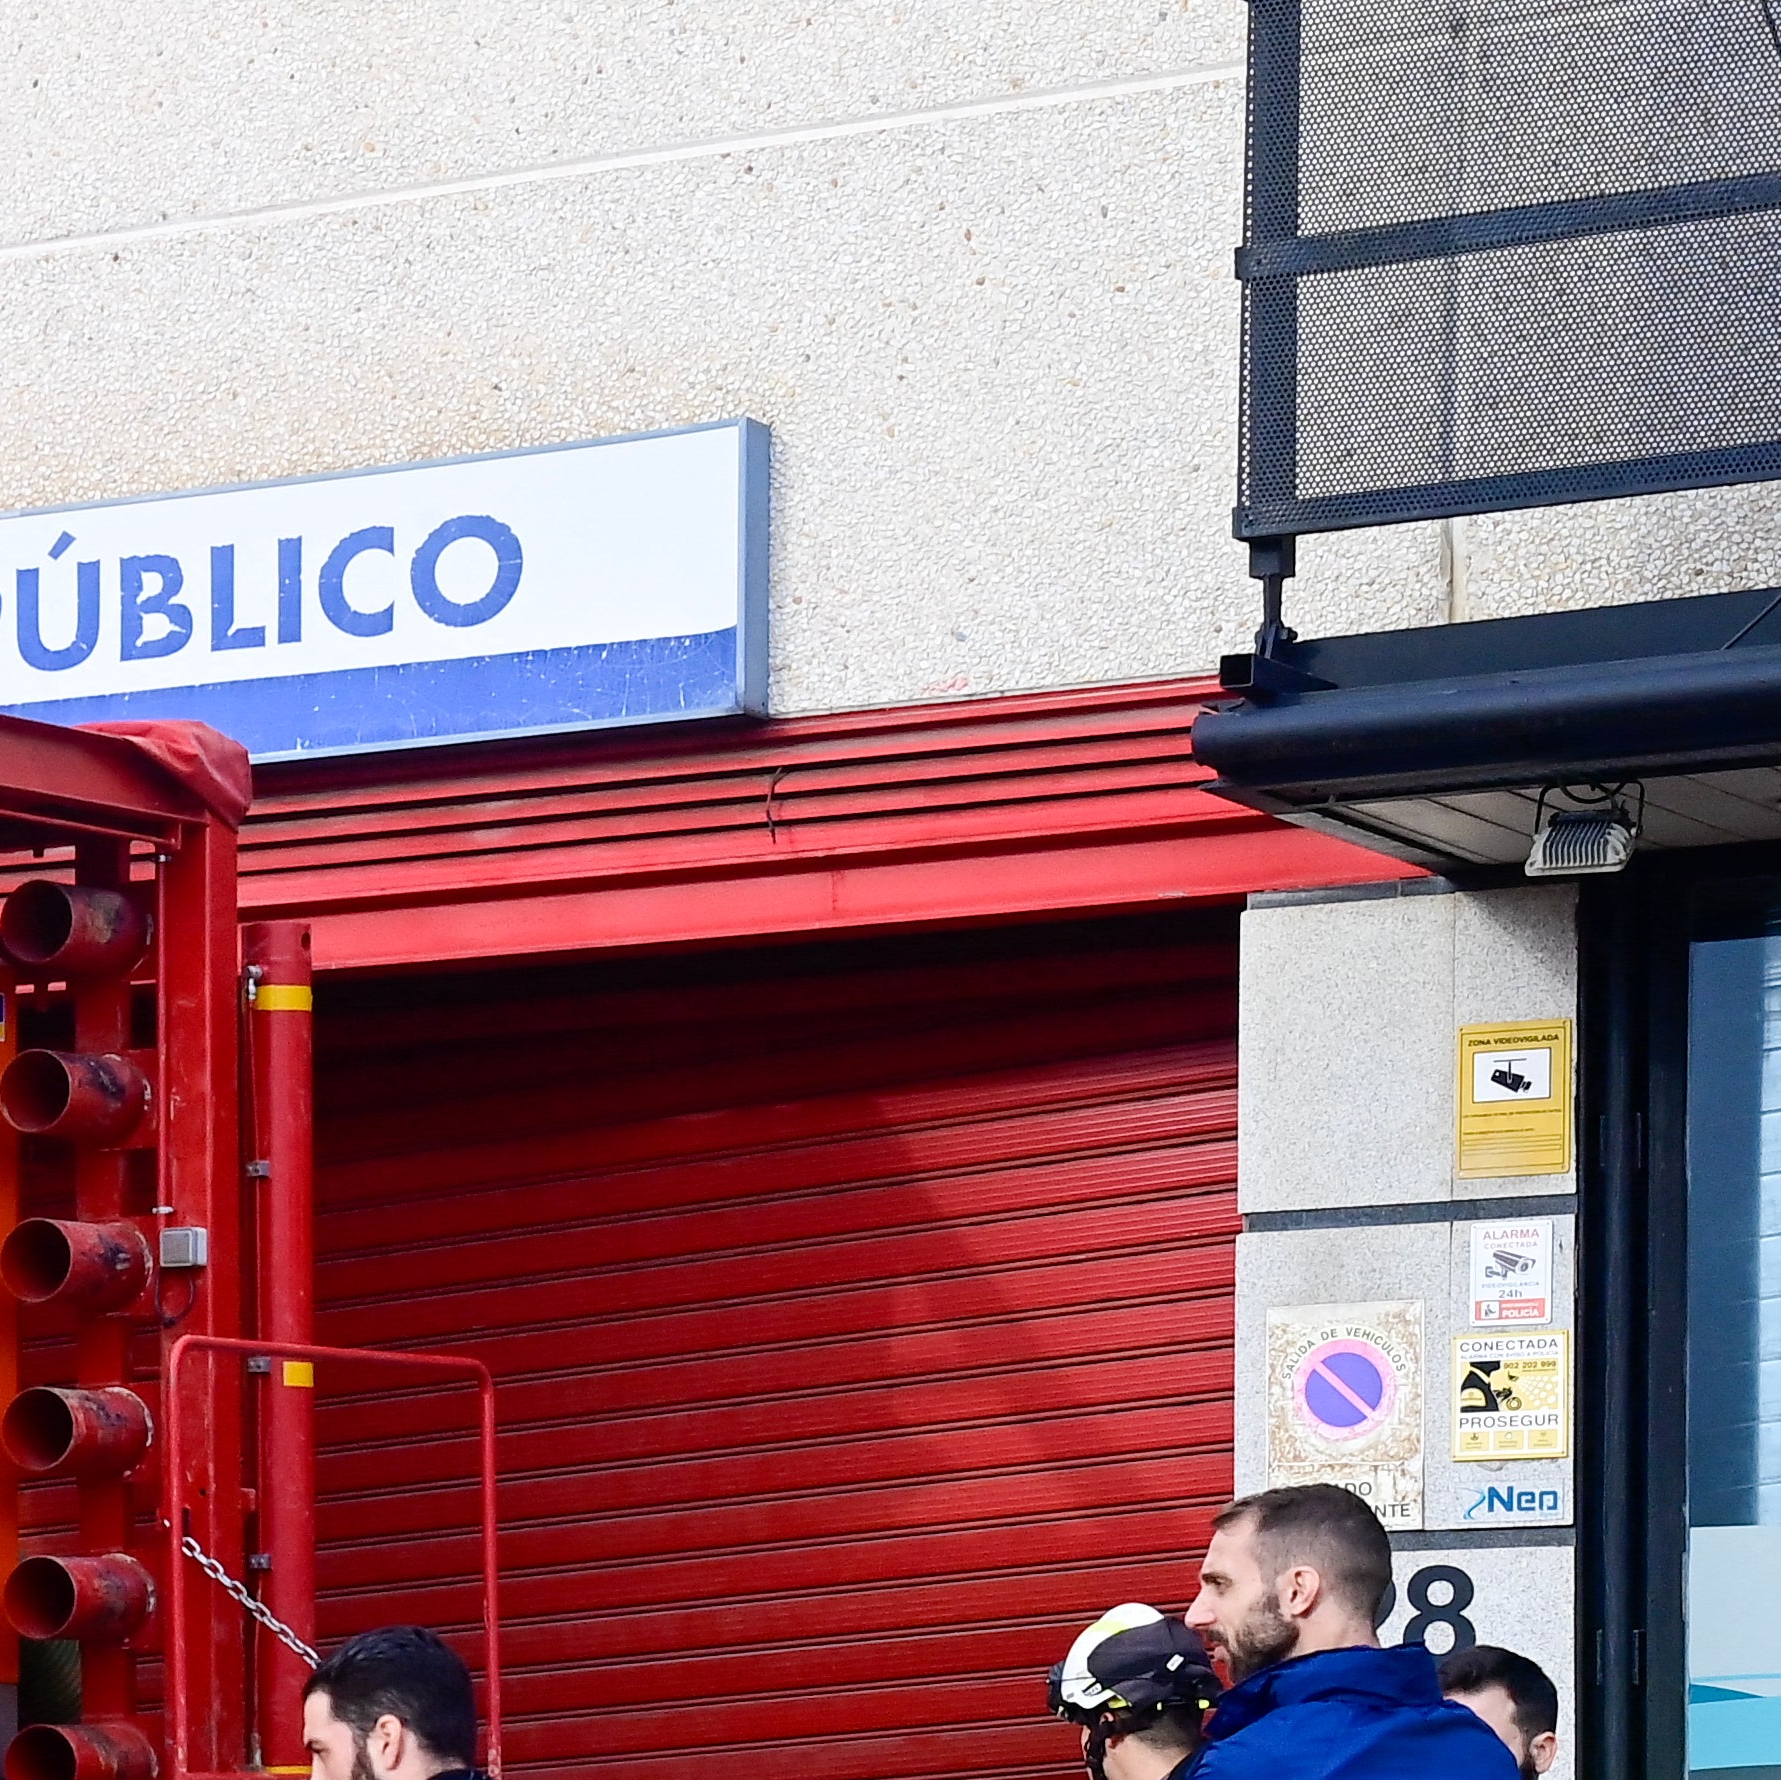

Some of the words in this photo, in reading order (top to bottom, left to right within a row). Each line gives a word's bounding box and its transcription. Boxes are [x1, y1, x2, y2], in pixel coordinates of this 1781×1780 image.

[1467, 1038, 1491, 1047] ZONA
[1493, 1033, 1559, 1045] VIDEOVIGILADA
[1483, 1228, 1540, 1240] ALARMA
[1483, 1241, 1538, 1250] CONECTADA
[1498, 1289, 1522, 1298] 24h
[1460, 1338, 1559, 1353] CONECTADA
[1282, 1340, 1316, 1380] SALIDA
[1320, 1328, 1339, 1341] DE
[1345, 1326, 1406, 1372] VEHICULOS
[1522, 1361, 1538, 1369] 202
[1459, 1413, 1559, 1429] PROSEGUR
[1334, 1482, 1373, 1497] DO
[1375, 1564, 1476, 1657] 8
